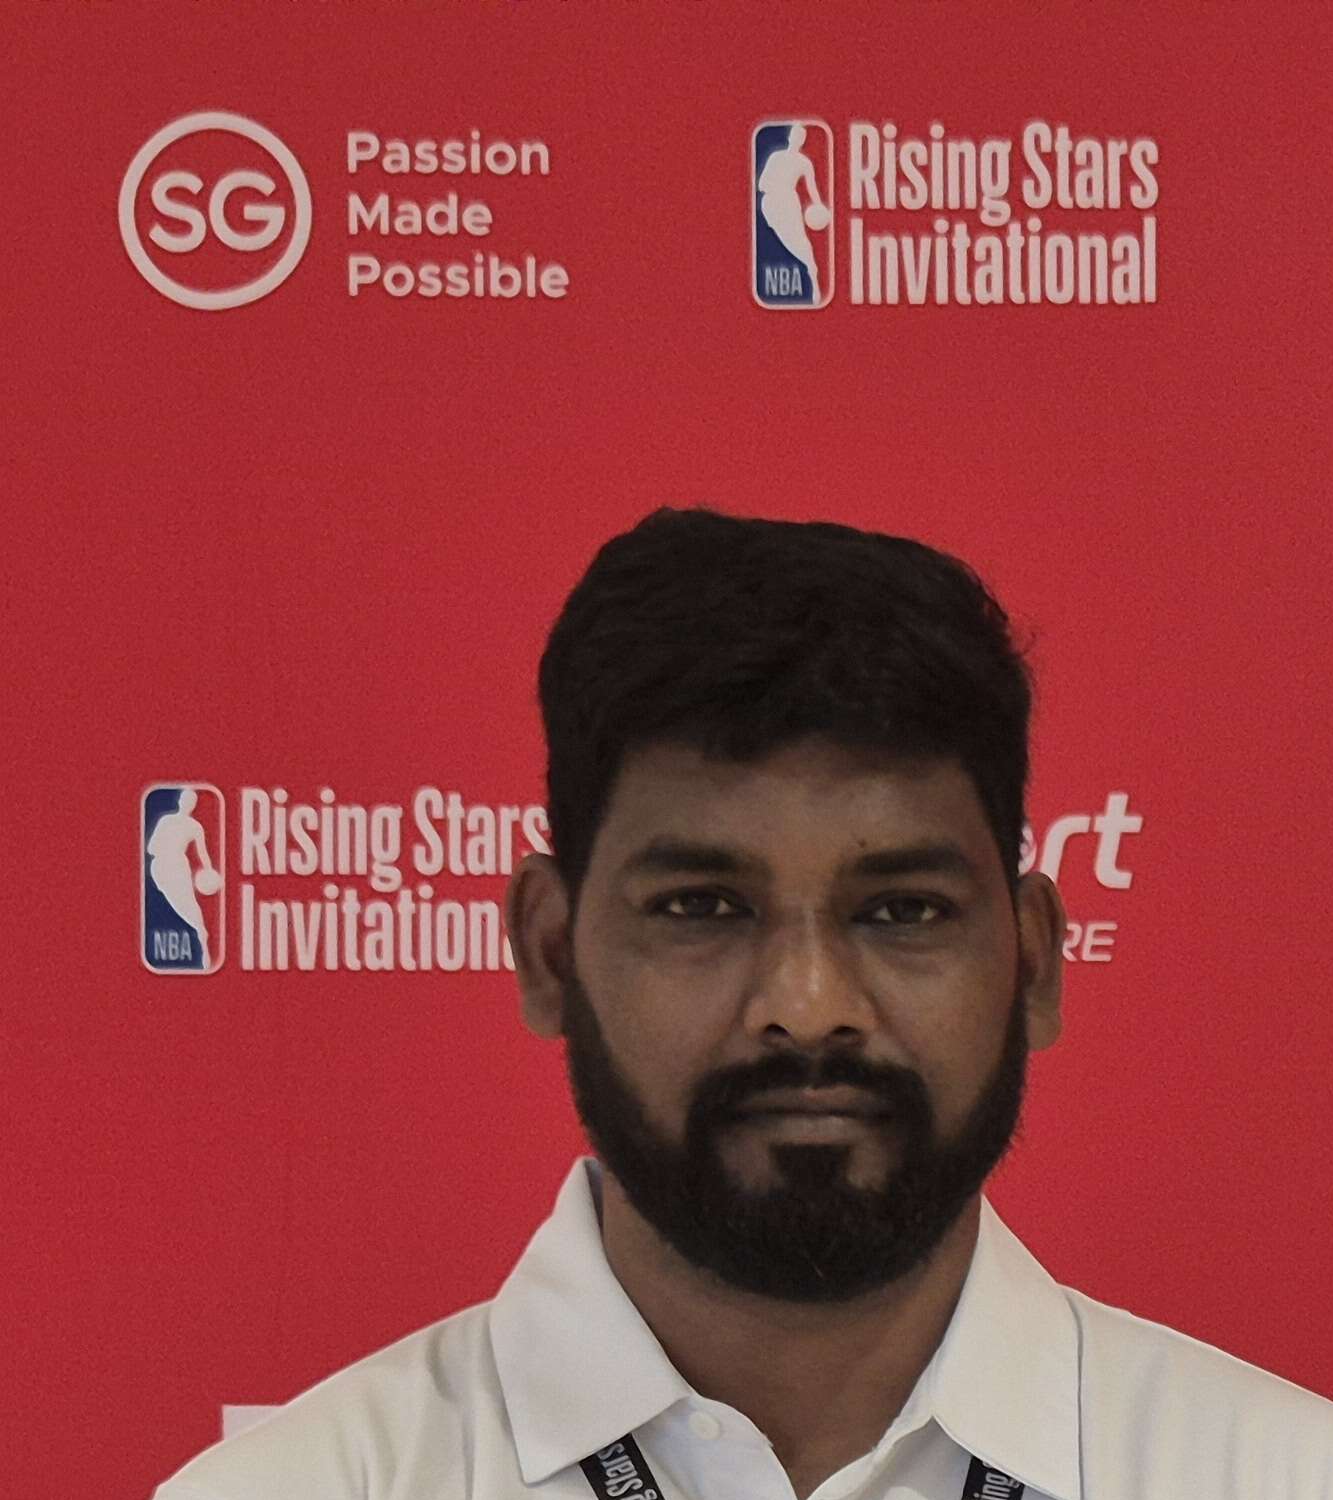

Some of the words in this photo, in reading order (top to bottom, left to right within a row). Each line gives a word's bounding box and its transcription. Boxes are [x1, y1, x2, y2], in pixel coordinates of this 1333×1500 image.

[347, 131, 551, 177] Passion
[849, 120, 1011, 224] Rising
[1022, 121, 1159, 210] Stars
[149, 170, 285, 253] SG
[347, 192, 493, 237] Made
[348, 253, 569, 301] Possible
[764, 266, 803, 297] NBA
[849, 216, 1158, 305] Invitational
[241, 787, 402, 892] Rising
[154, 931, 192, 961] NBA
[241, 884, 515, 971] Invitation
